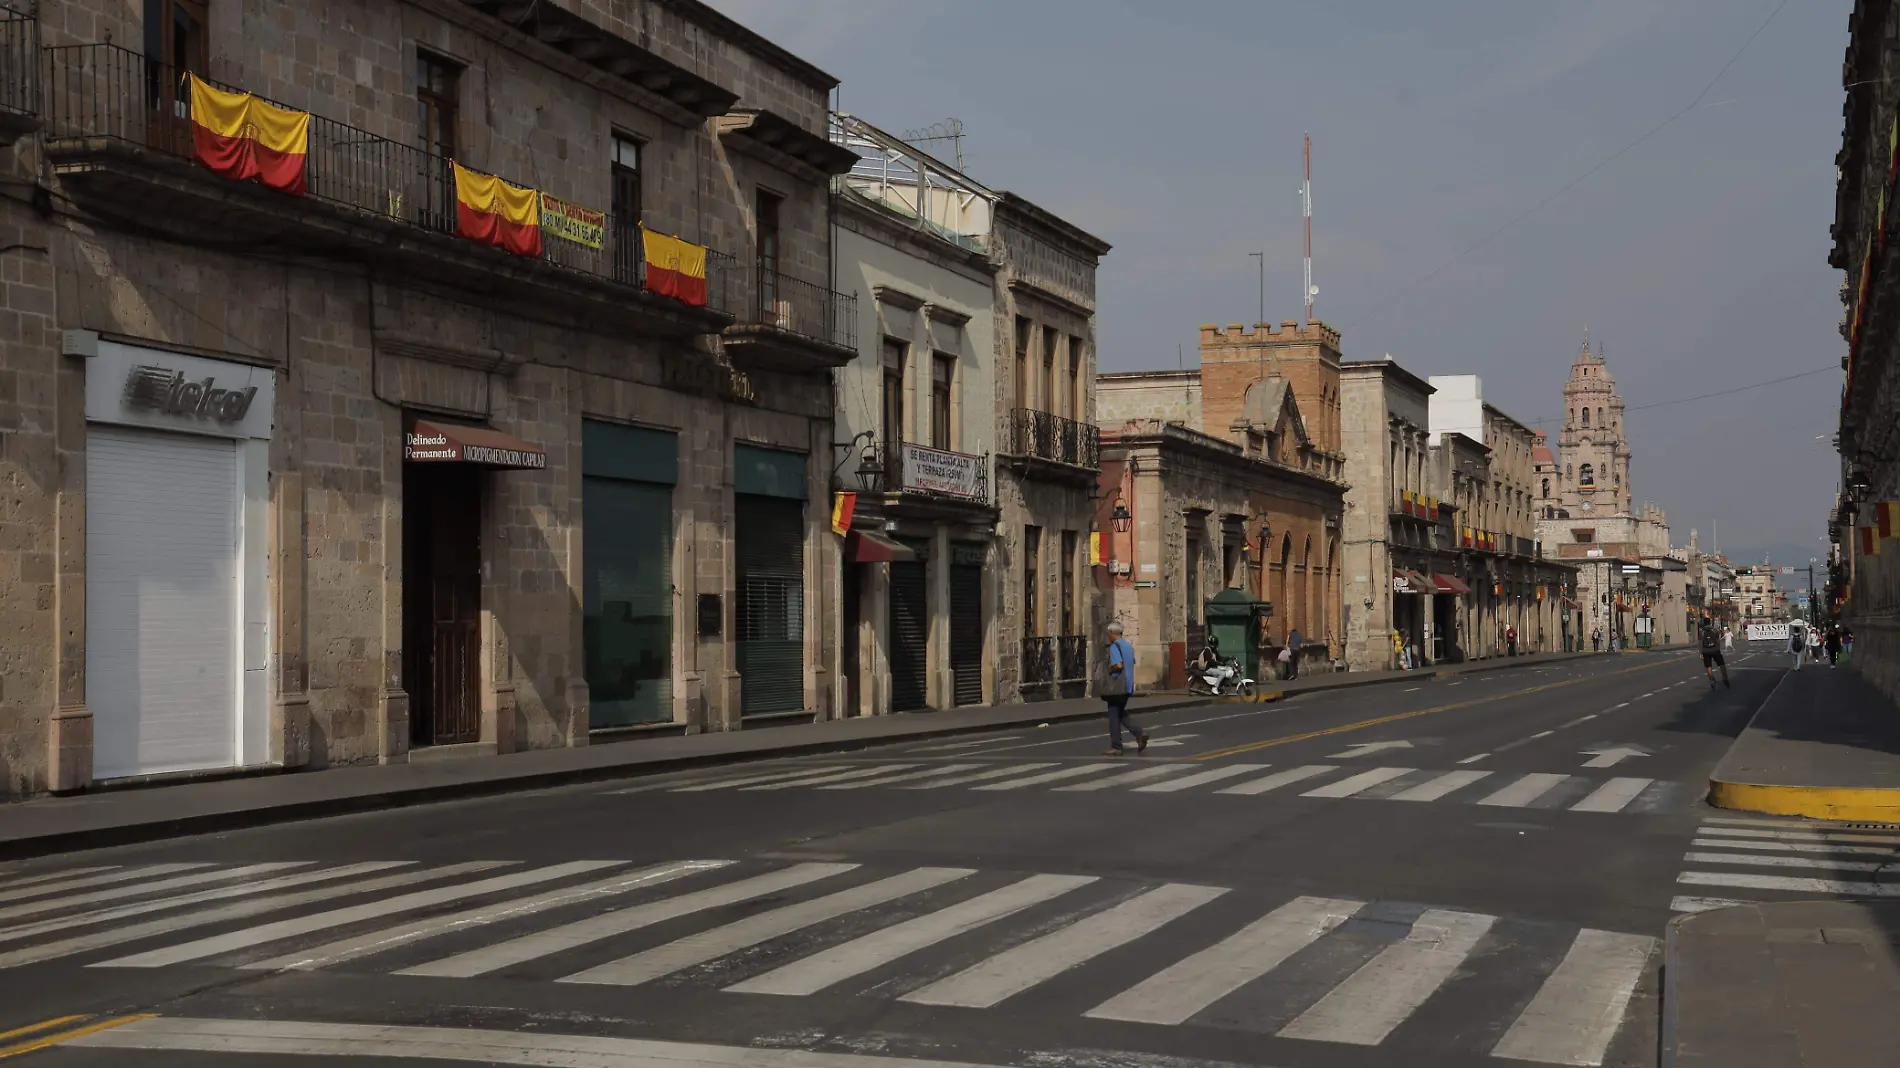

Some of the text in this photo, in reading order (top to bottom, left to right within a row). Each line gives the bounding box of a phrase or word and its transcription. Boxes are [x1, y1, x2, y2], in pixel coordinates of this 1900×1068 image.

[168, 369, 258, 421] telcel
[406, 433, 447, 446] Delineado
[404, 446, 456, 459] Permanente
[522, 452, 546, 468] CAPILAR
[910, 449, 918, 460] SE
[918, 451, 936, 464] RENTA
[916, 463, 920, 474] Y
[922, 464, 946, 478] TERRAZA
